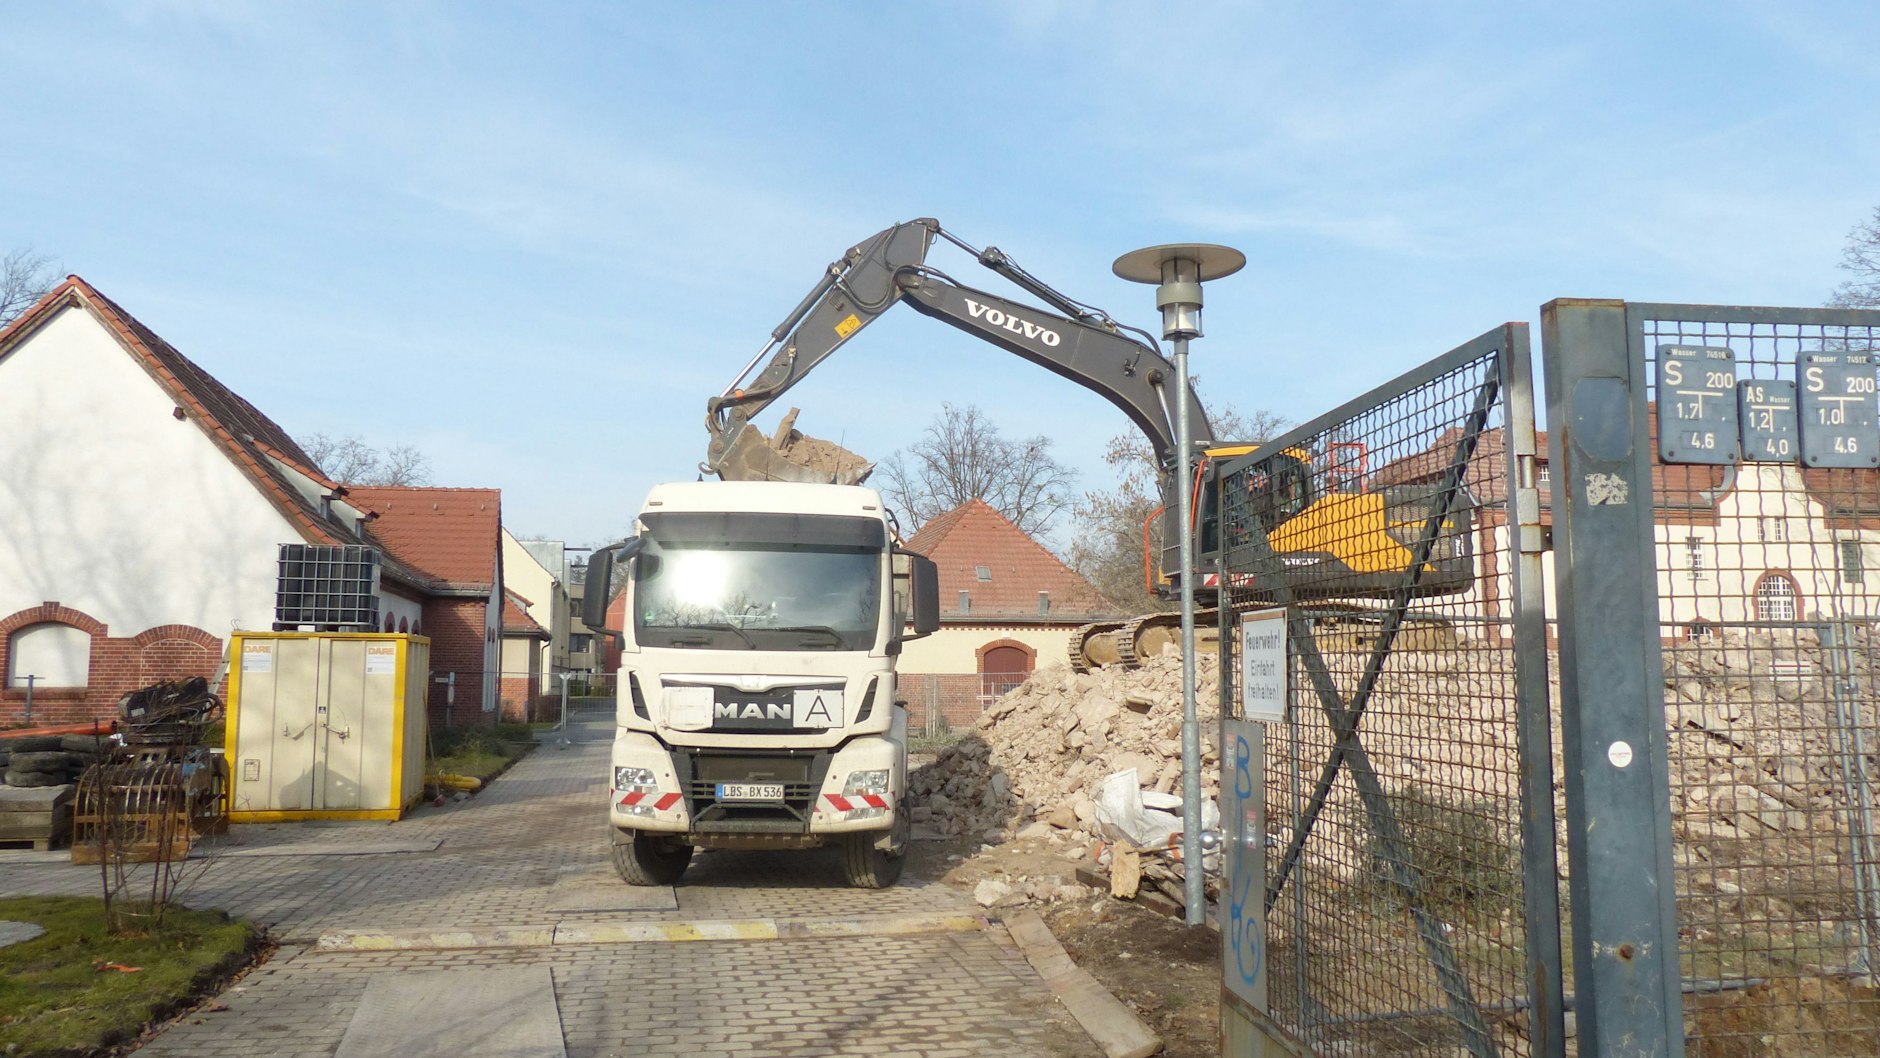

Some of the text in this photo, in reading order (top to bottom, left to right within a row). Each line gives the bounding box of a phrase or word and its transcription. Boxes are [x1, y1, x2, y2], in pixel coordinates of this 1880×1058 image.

[964, 298, 1061, 347] VOLVO
[1671, 349, 1697, 357] Wasser
[1812, 355, 1838, 363] Wasser
[1664, 360, 1734, 388] S 200
[1806, 367, 1875, 393] S 200
[1746, 386, 1764, 403] AS
[1766, 438, 1788, 457] 4,0
[1246, 629, 1280, 651] Feuerwehr!
[368, 647, 395, 655] DARE
[715, 703, 791, 719] MAN
[805, 695, 832, 722] A
[723, 786, 782, 798] LBS BX 536
